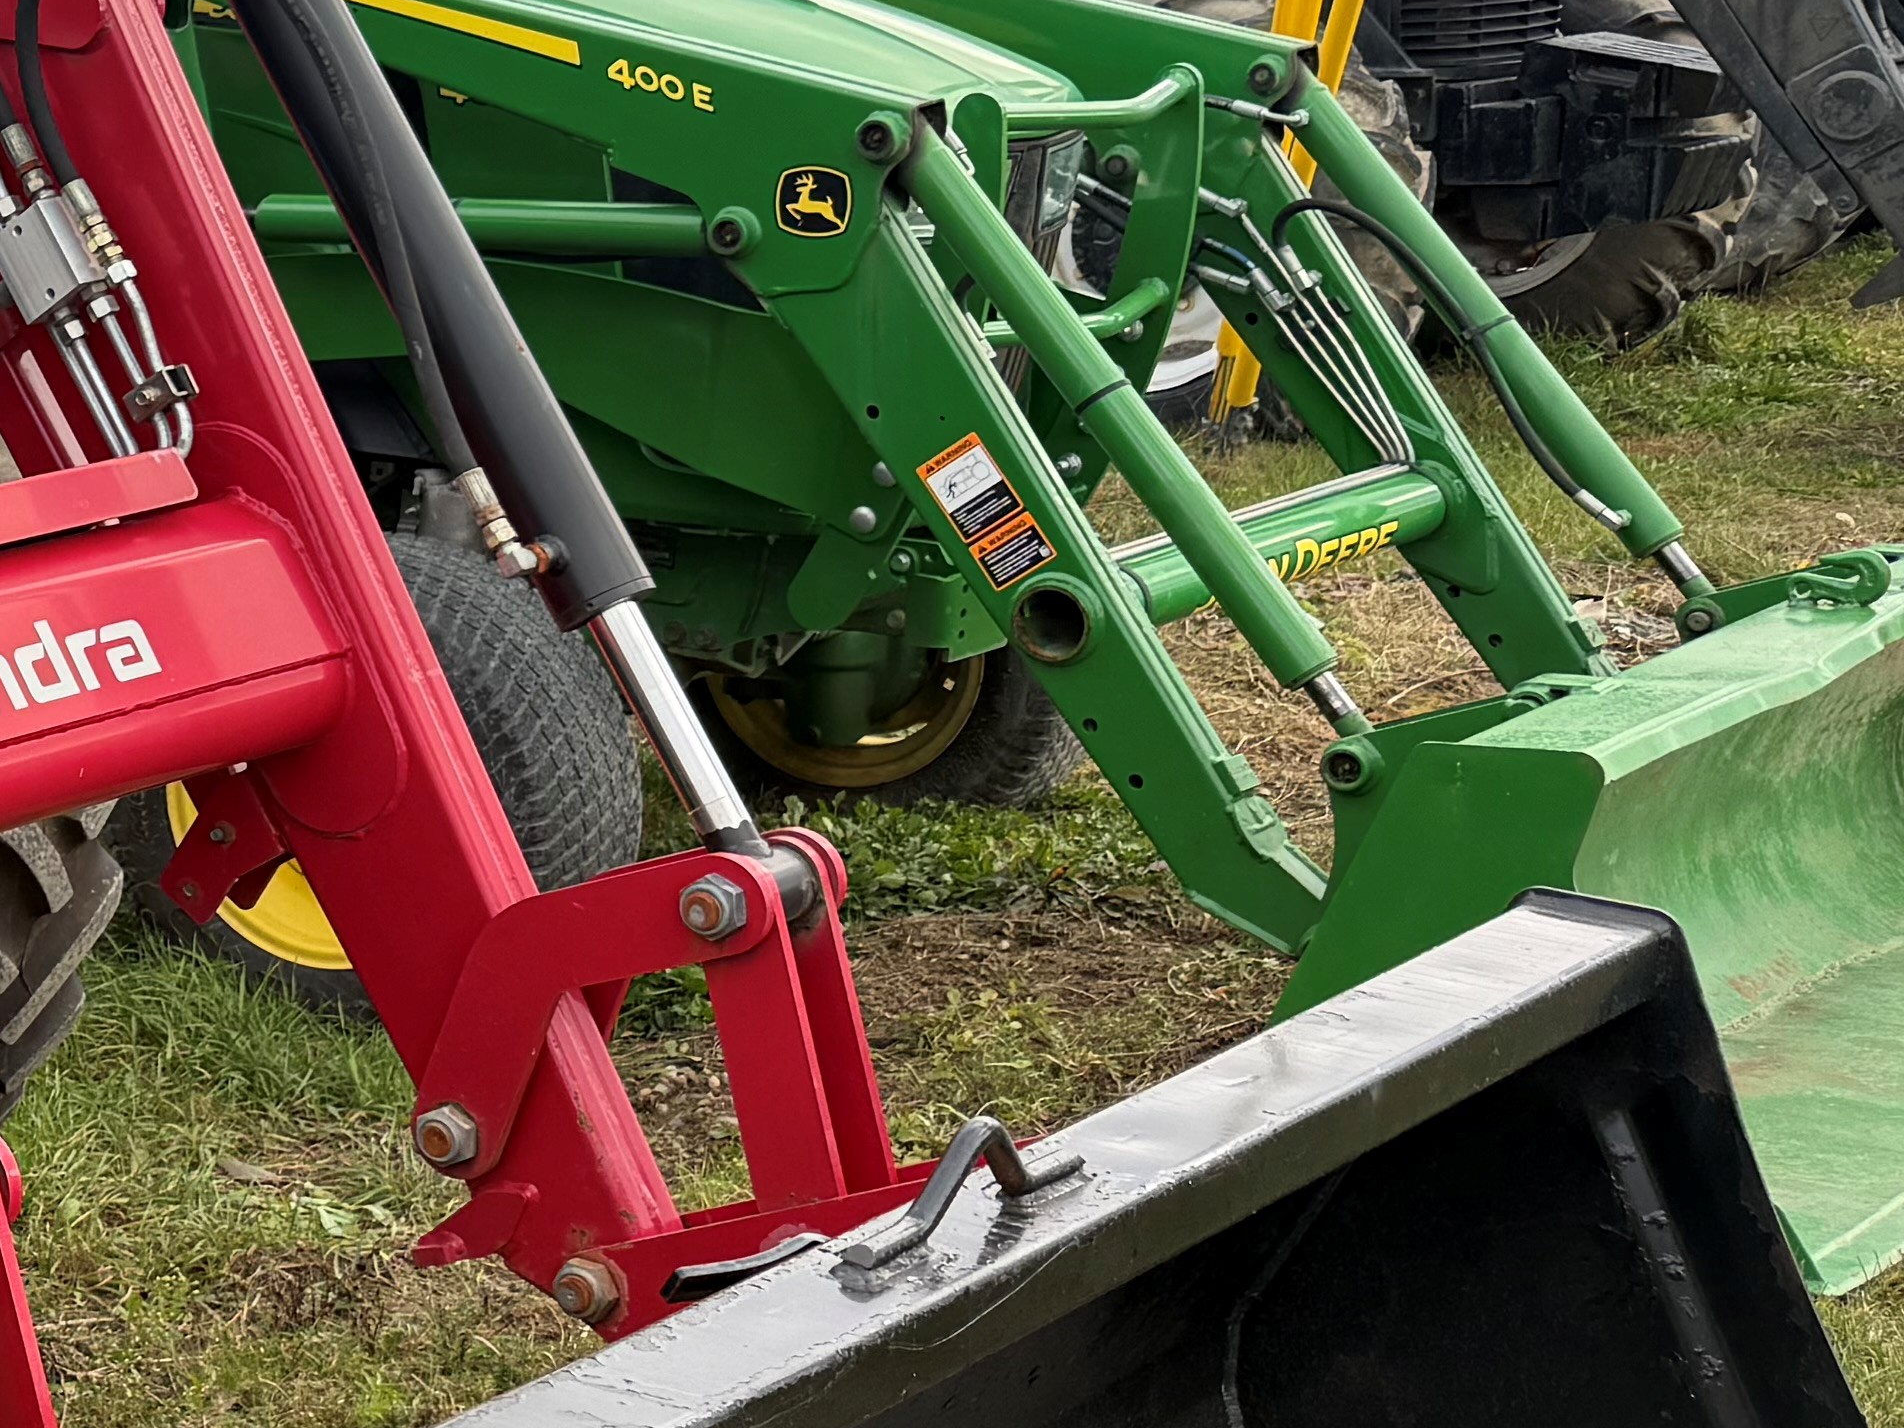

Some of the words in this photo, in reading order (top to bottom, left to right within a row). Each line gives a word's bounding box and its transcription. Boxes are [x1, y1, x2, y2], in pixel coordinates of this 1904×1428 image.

[607, 58, 685, 101] 400
[692, 82, 715, 113] E
[1288, 520, 1400, 583] DEERE
